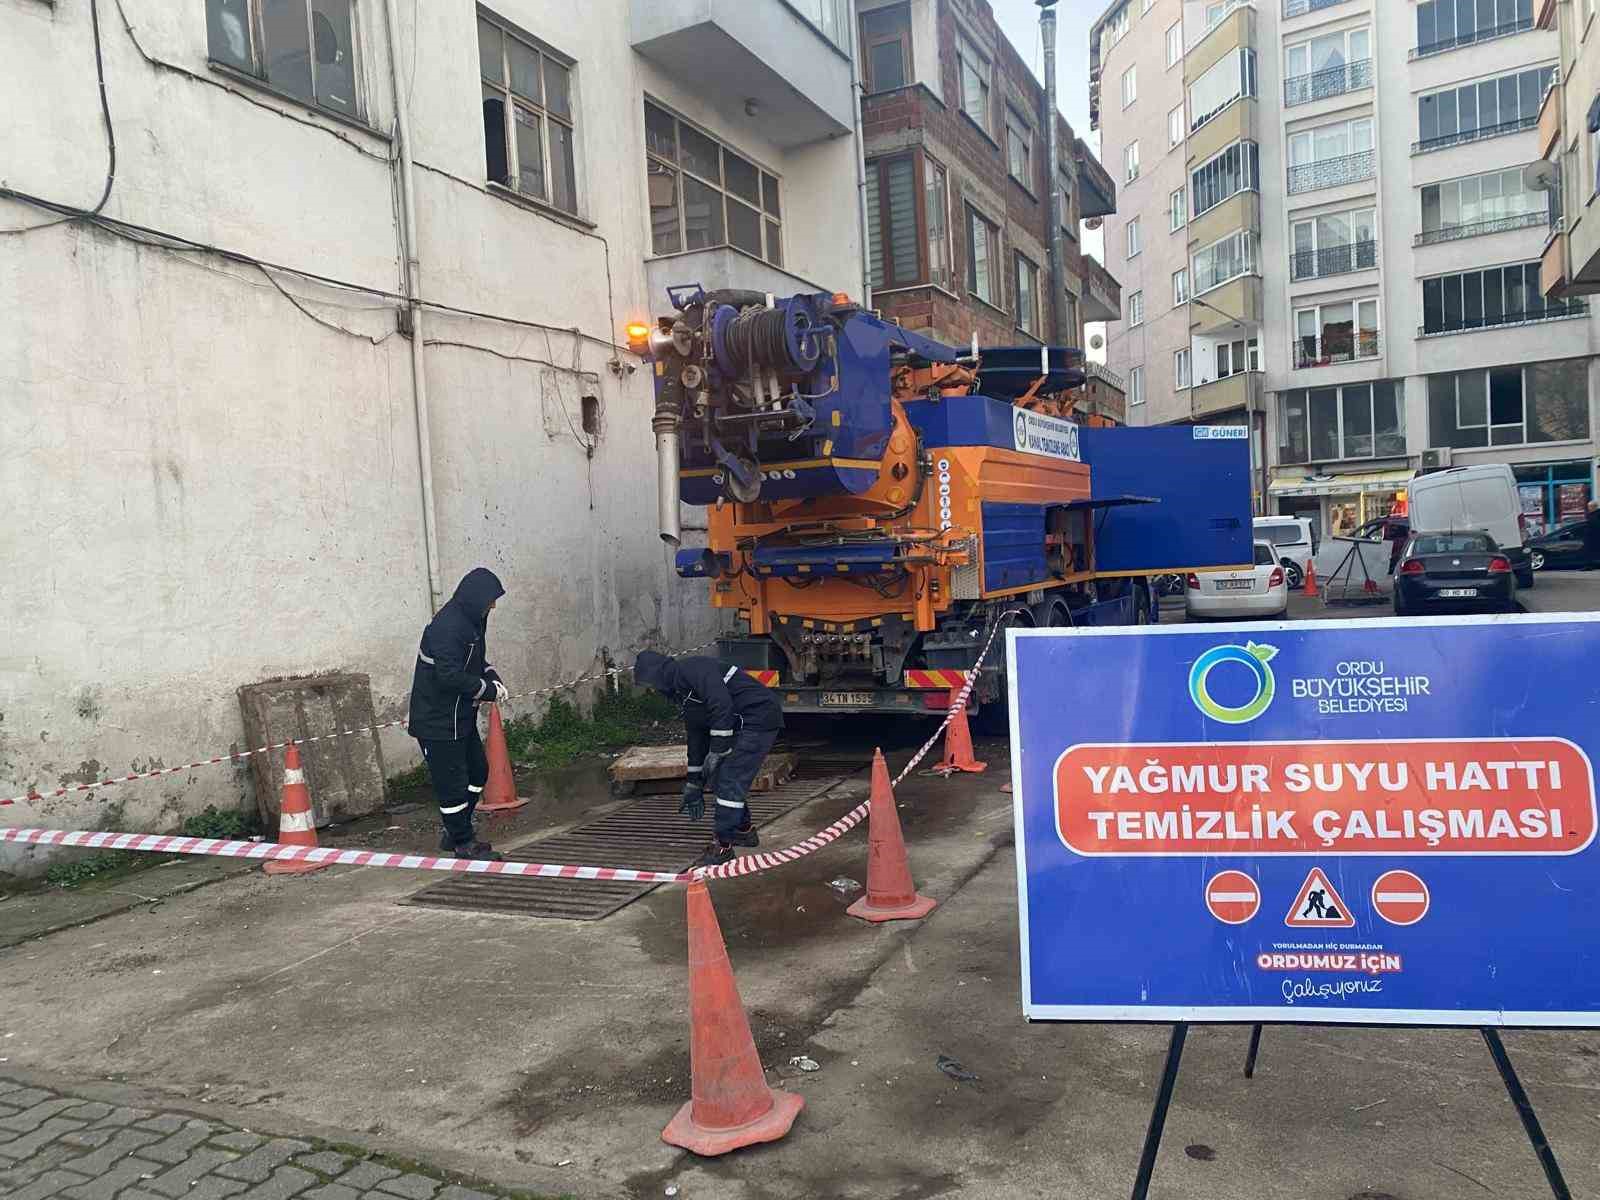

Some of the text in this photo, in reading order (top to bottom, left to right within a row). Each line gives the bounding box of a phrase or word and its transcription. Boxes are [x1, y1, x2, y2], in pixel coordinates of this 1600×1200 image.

[1336, 661, 1384, 676] ORDU
[1292, 676, 1430, 698] BÜYÜKŞEHİR
[1319, 698, 1408, 713] BELEDİYESİ
[1083, 758, 1562, 794] YAĞMUR SUYU HATTI
[1088, 804, 1563, 846] TEMİZLİK ÇALIŞMASI
[1325, 942, 1338, 951] HİÇ
[1258, 953, 1401, 973] ORDUMUZ İÇİN
